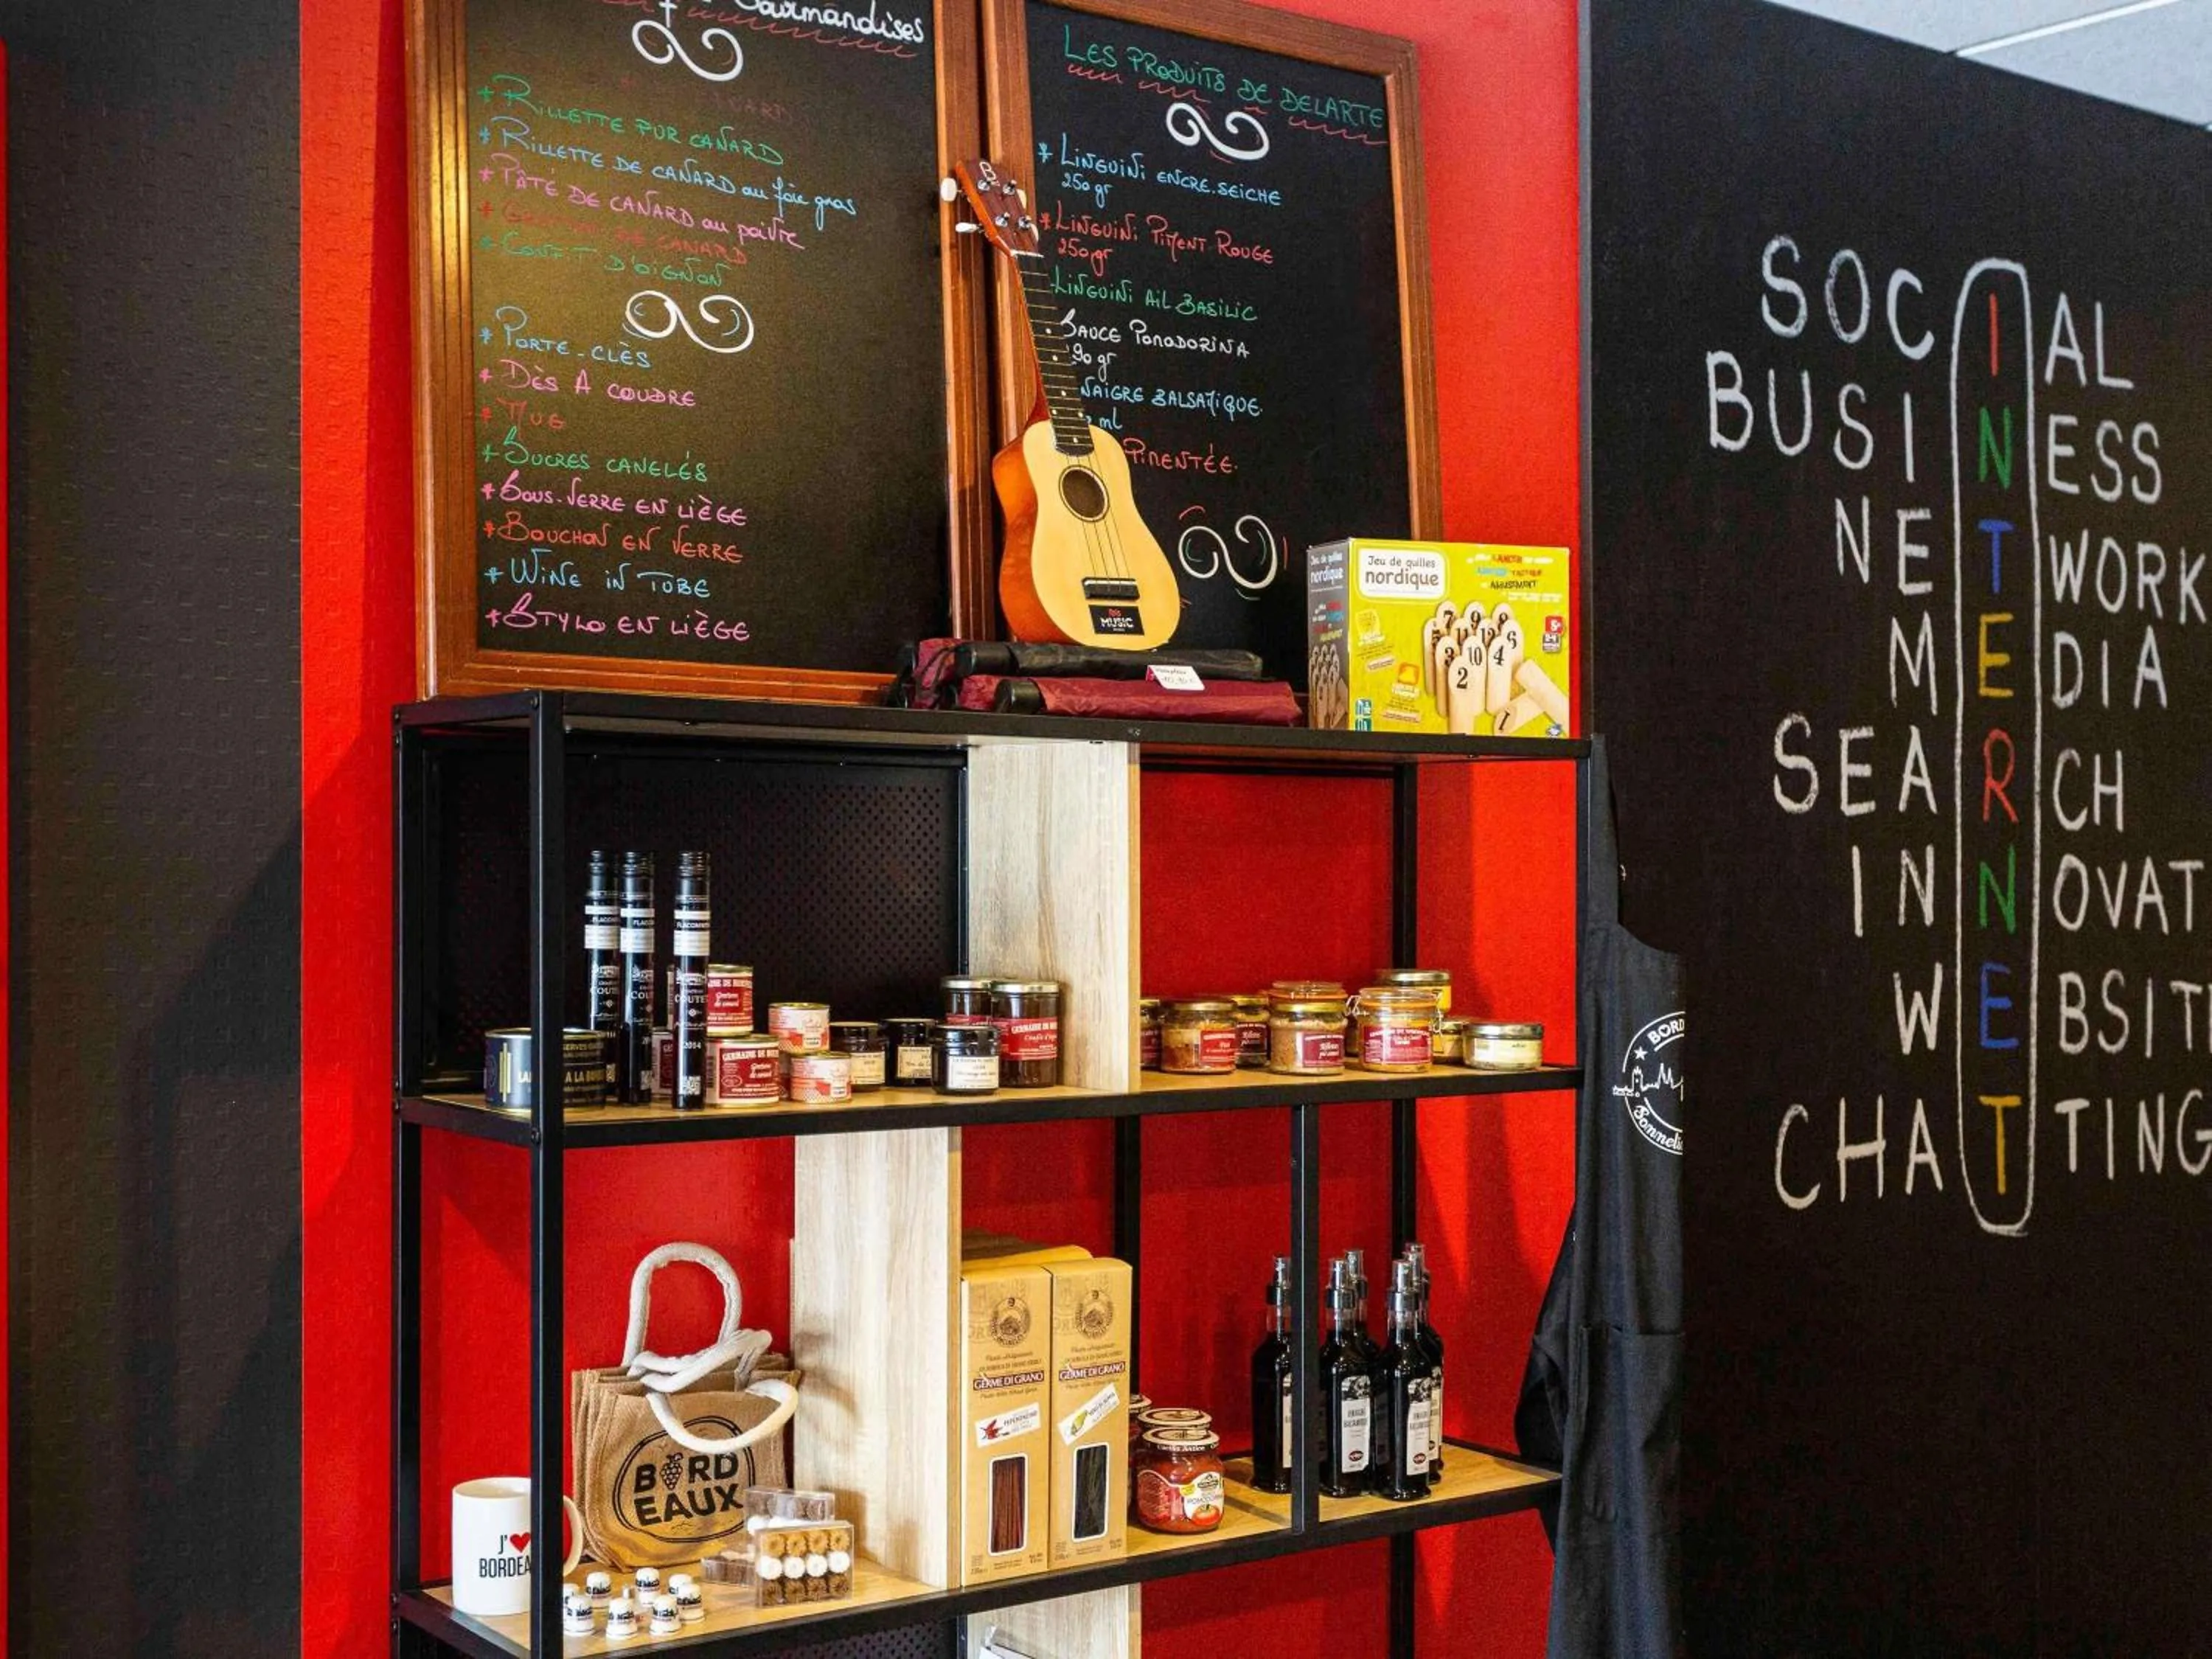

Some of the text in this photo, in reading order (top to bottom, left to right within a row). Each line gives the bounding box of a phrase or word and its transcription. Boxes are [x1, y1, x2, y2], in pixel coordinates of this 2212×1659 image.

[1063, 24, 1119, 68] LES
[1237, 78, 1273, 104] DE
[1280, 87, 1385, 128] DELARTE
[612, 155, 643, 175] DE
[742, 186, 769, 200] au
[814, 195, 857, 231] gras
[568, 184, 599, 208] DE
[702, 218, 730, 234] au
[1215, 230, 1274, 266] ROUGE
[1060, 308, 1122, 343] SAUCE
[1097, 352, 1117, 383] gr
[574, 369, 591, 394] A
[608, 382, 696, 406] COUDRE
[635, 502, 669, 515] EN
[497, 510, 744, 563] BOUCHON EN VERRE
[1368, 555, 1436, 571] Jeu de quilles
[1365, 569, 1439, 590] nordique
[618, 617, 660, 634] EN
[1099, 616, 1134, 628] MUSIC
[1443, 610, 1454, 628] 7
[1470, 610, 1481, 628] 9
[1506, 630, 1517, 649] 6
[1444, 645, 1505, 667] 3 10 4
[1456, 667, 1468, 689] 2
[1893, 961, 2212, 1059] WEBSIT
[633, 1484, 744, 1526] EAUX
[479, 1555, 531, 1579] BORDEA
